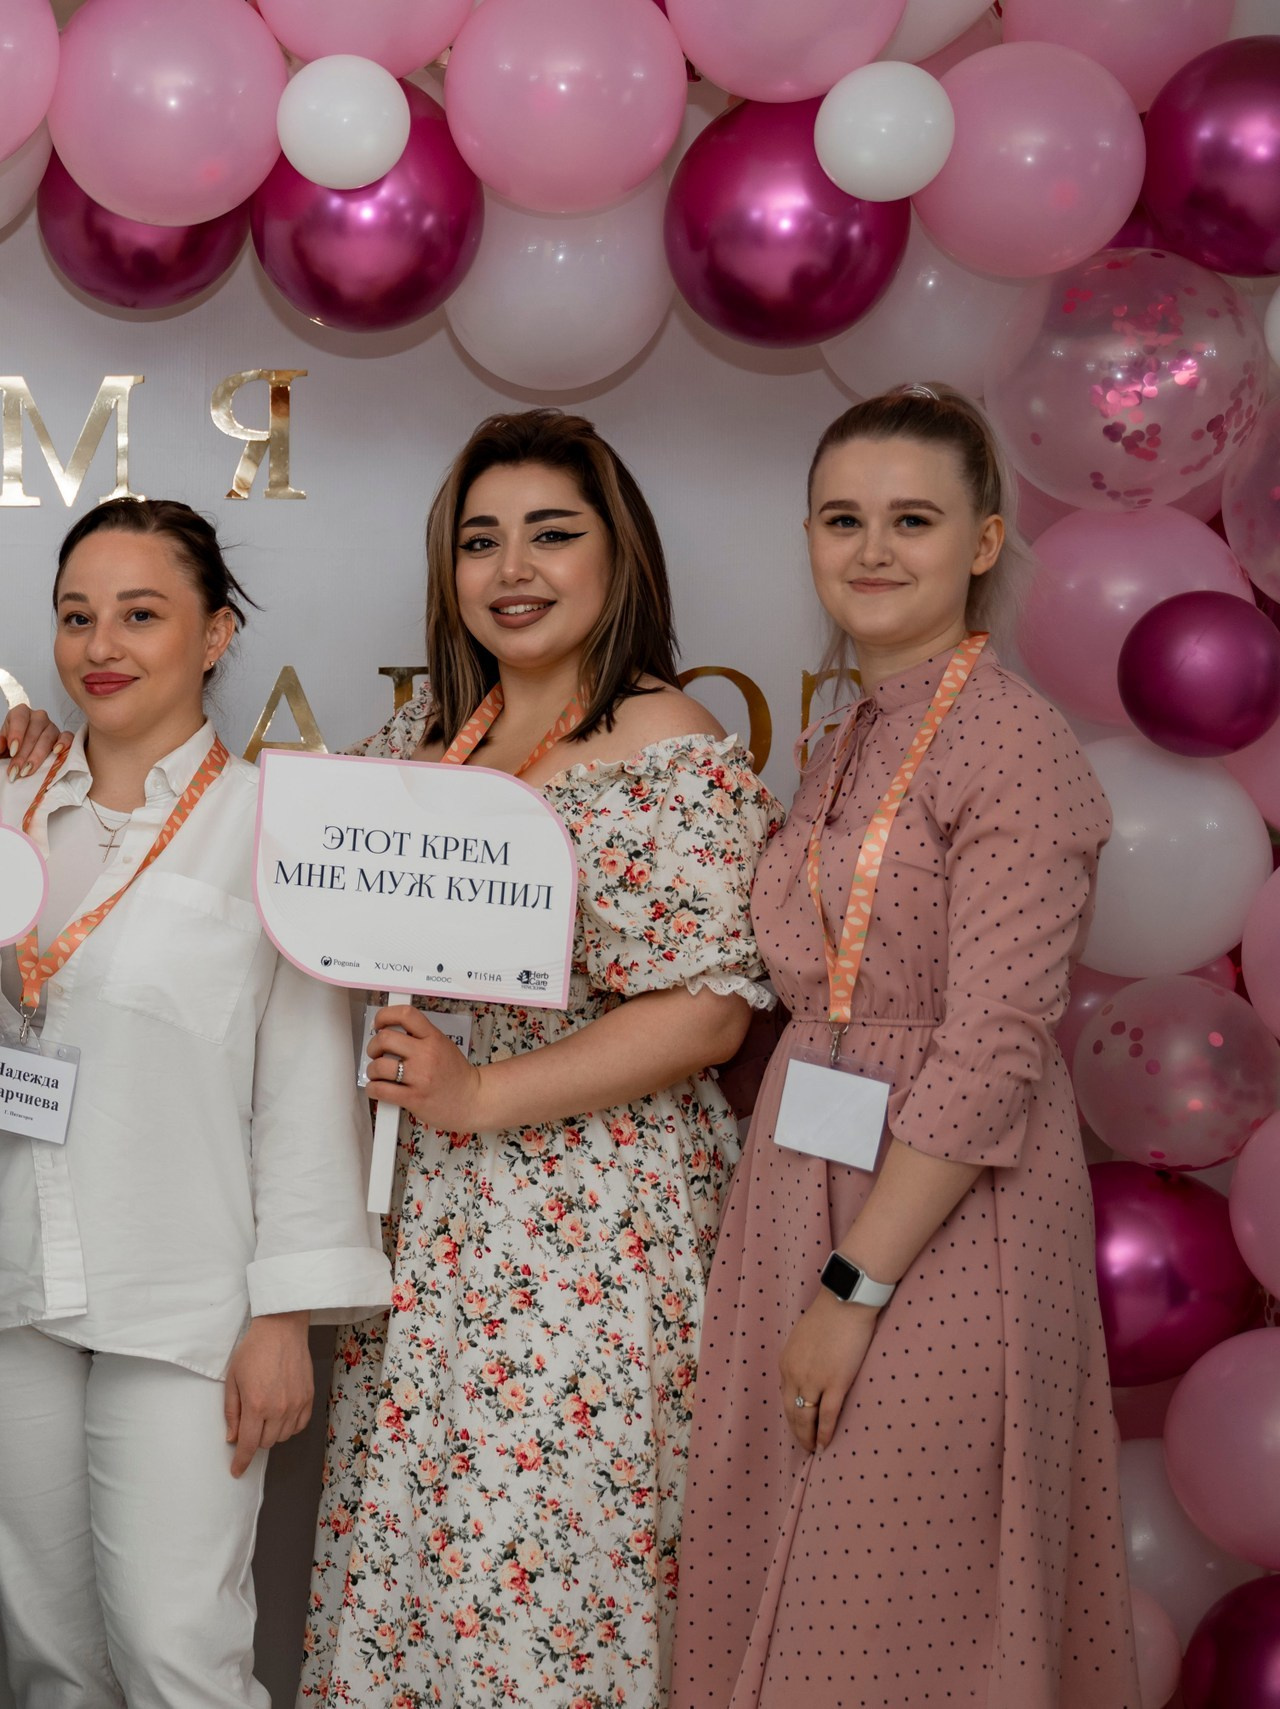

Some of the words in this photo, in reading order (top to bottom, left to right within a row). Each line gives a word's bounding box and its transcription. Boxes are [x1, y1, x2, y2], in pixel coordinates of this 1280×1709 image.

[322, 824, 412, 857] ЭТОТ
[420, 833, 511, 866] КРЕМ
[273, 860, 346, 891] МНЕ
[356, 867, 437, 899] МУЖ
[446, 875, 553, 910] КУПИЛ
[473, 971, 502, 983] TISHA
[529, 970, 550, 980] Herb
[529, 977, 548, 987] Care
